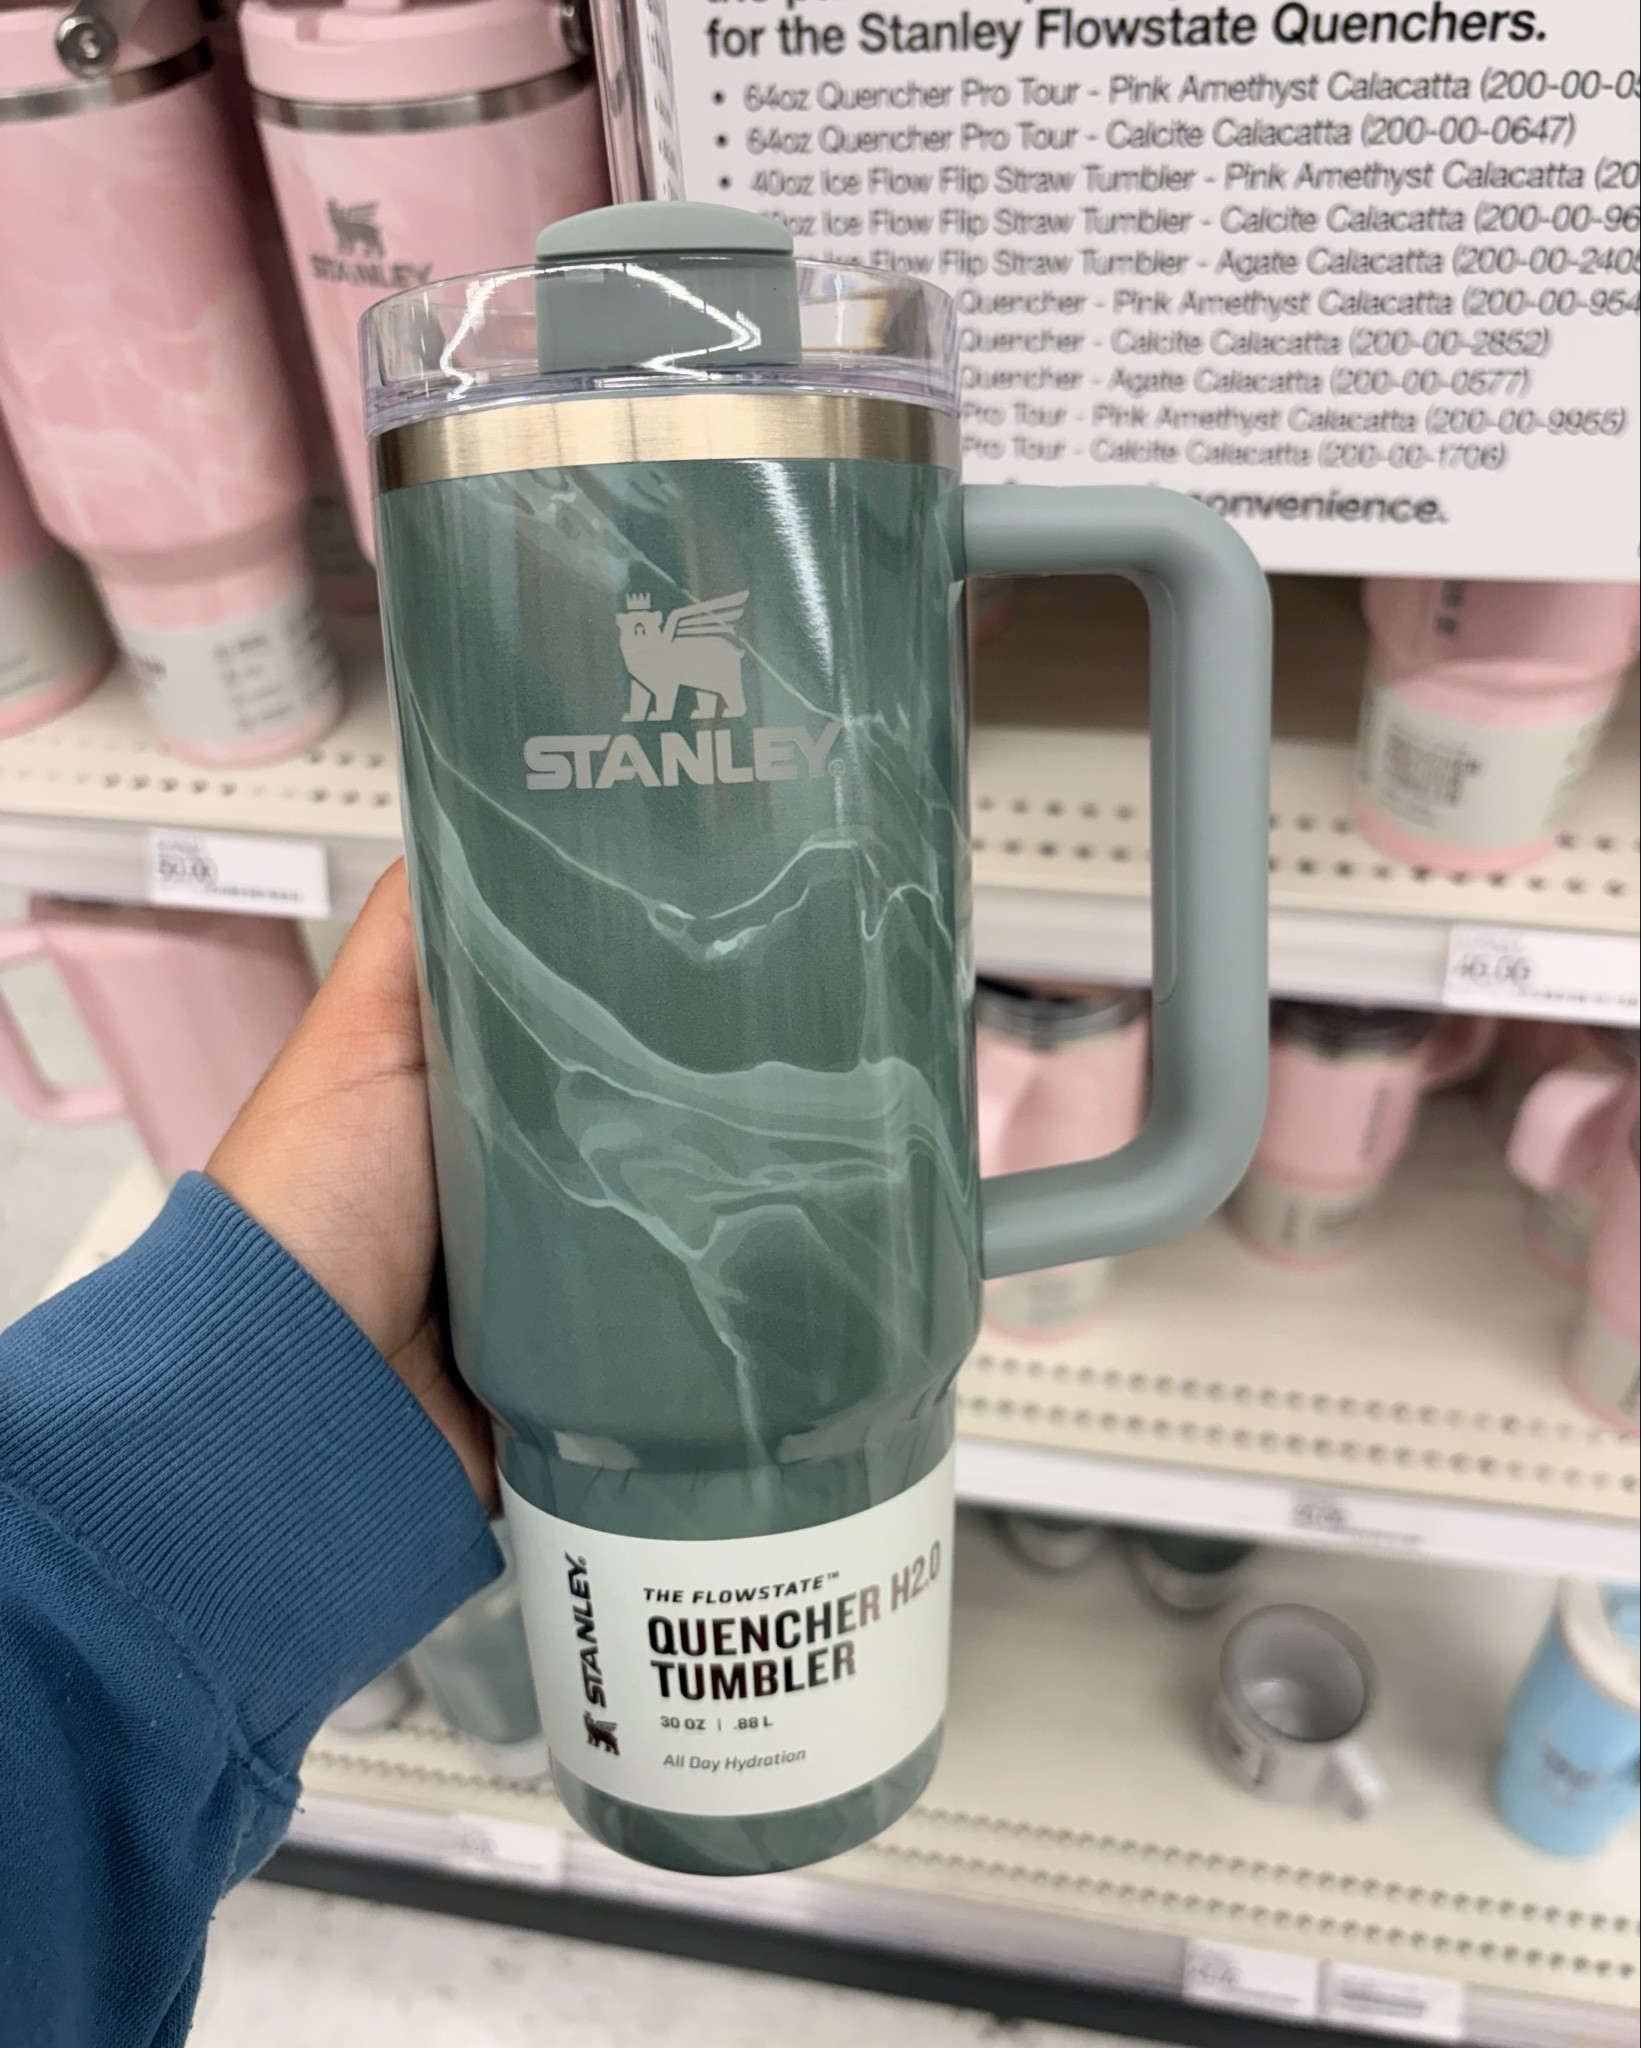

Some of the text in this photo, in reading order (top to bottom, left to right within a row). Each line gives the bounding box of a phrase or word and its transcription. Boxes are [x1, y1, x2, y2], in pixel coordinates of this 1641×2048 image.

[705, 1, 1547, 60] for the Stanley Flowstate Quenchers.
[743, 81, 811, 112] 64oz
[815, 79, 954, 111] Quencher
[961, 77, 1012, 107] Pro
[1016, 75, 1081, 106] Tour
[1108, 73, 1172, 104] Pink
[1177, 72, 1319, 109] Amethyst
[1326, 69, 1471, 101] Calacatta
[746, 125, 813, 156] 64oz
[818, 123, 953, 154] Quencher
[960, 121, 1011, 151] Pro
[1015, 120, 1079, 151] Tour
[1105, 118, 1205, 150] Calcite
[1212, 115, 1352, 148] Calacatta
[1361, 111, 1577, 149] (200-00-0647)
[749, 167, 817, 198] 40oz
[820, 166, 862, 196] Ice
[867, 165, 935, 195] Flow
[938, 164, 989, 200] Flip
[993, 164, 1076, 195] Straw
[1082, 161, 1197, 194] Tumbler
[1224, 160, 1287, 191] Pink
[1293, 158, 1435, 196] Amethyst
[1442, 157, 1585, 190] Calacatta
[822, 208, 864, 237] Ice
[868, 207, 936, 237] Flow
[938, 206, 989, 241] Flip
[993, 205, 1076, 236] Straw
[1080, 204, 1194, 235] Tumbler
[1219, 203, 1319, 235] Calcite
[1325, 201, 1466, 234] Calacatta
[938, 247, 988, 282] Flip
[993, 247, 1075, 277] Straw
[1079, 246, 1193, 277] Tumbler
[1213, 246, 1300, 283] Agate
[1306, 244, 1446, 276] Calacatta
[955, 286, 1088, 316] Quencher
[1112, 286, 1173, 316] Pink
[1177, 285, 1312, 323] Amethyst
[1317, 286, 1456, 317] Calacatta
[1208, 325, 1342, 357] Calacatta
[1192, 364, 1323, 395] Calacatta
[1286, 404, 1417, 434] Calacatta
[1184, 436, 1313, 468] Calacatta
[1190, 487, 1449, 524] onvenience.
[643, 1587, 684, 1604] THE
[647, 1539, 942, 1658] QUENCHER H2.0
[650, 1639, 857, 1701] TUMBLER
[660, 1715, 680, 1730] 30
[684, 1716, 706, 1731] OZ
[763, 1714, 774, 1728] L
[663, 1747, 807, 1774] All Day Hydration
